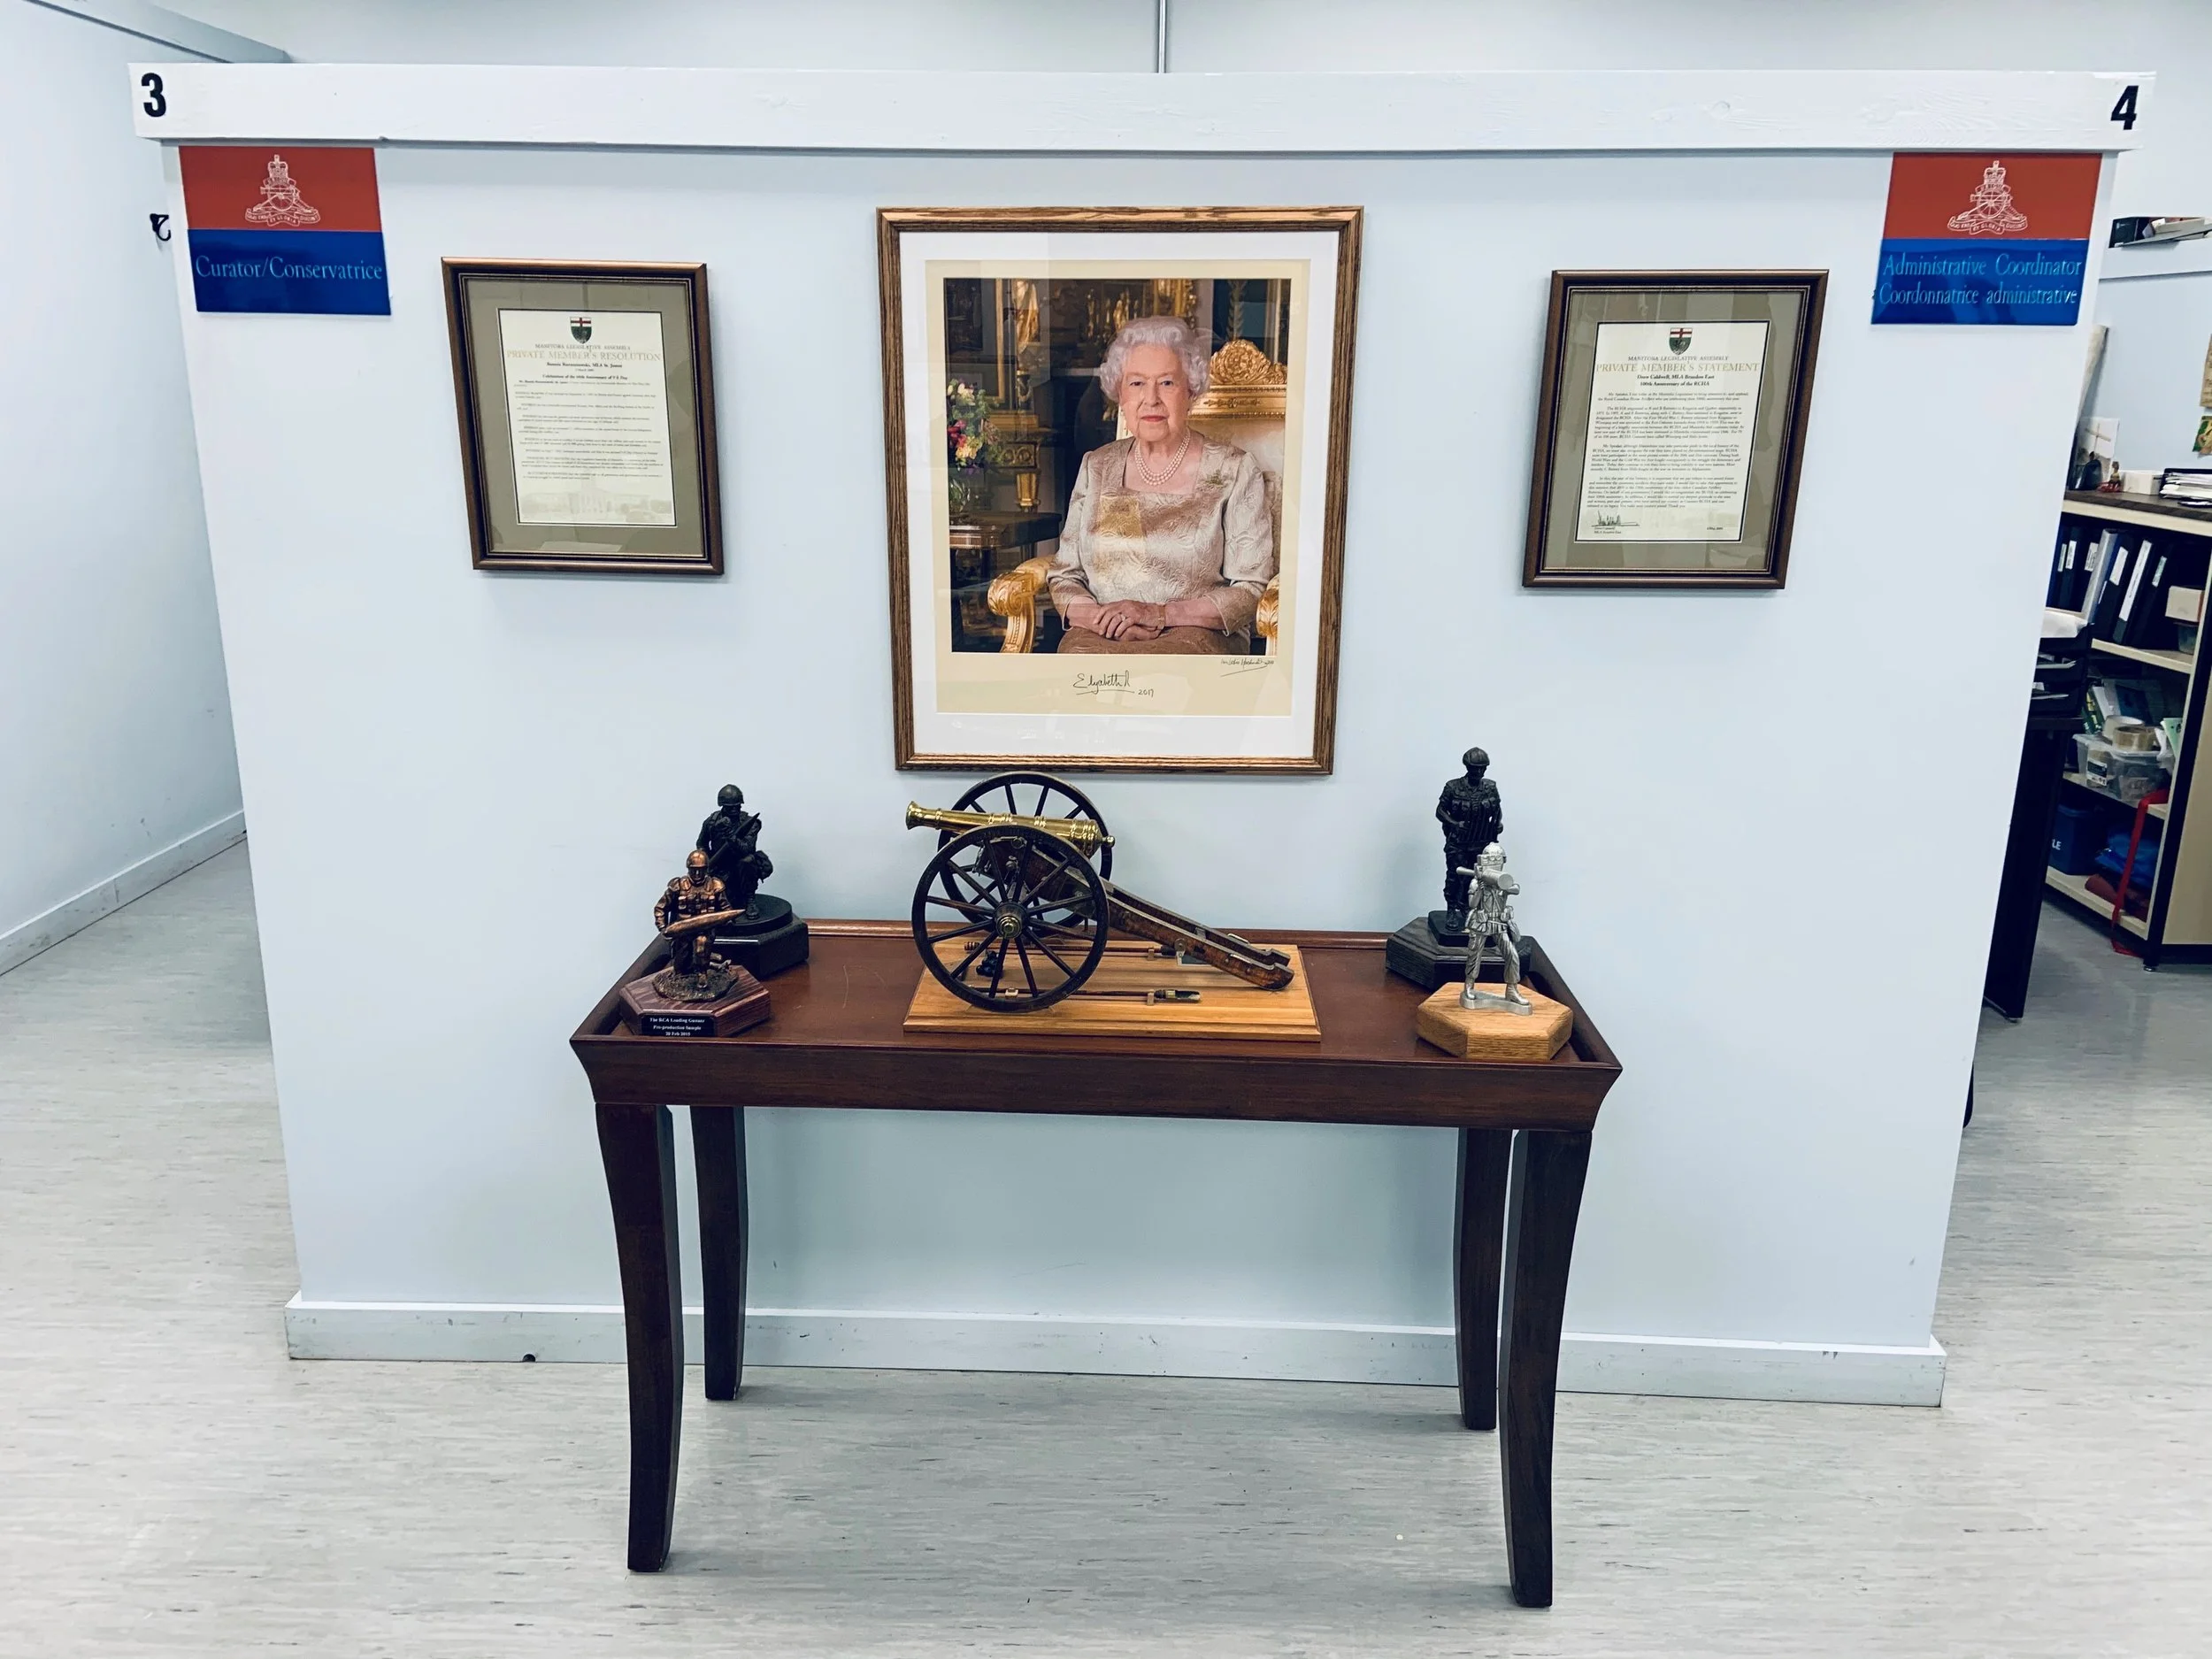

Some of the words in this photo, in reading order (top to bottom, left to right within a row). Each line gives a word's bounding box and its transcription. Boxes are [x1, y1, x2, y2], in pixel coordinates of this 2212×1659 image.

[141, 72, 166, 118] 3
[2110, 85, 2139, 130] 4
[196, 255, 383, 280] Curator/Conservatrice
[1882, 251, 1987, 276] Administrative
[1995, 252, 2083, 276] Coordinator
[1879, 281, 1980, 305] Coordonnatrice
[1986, 281, 2078, 305] administrative
[506, 349, 546, 358] PRIVATE
[548, 350, 597, 360] MEMBER'S
[600, 351, 661, 361] RESOLUTION
[1596, 363, 1639, 373] PRIVATE
[1640, 361, 1694, 373] MEMBER'S
[1698, 363, 1759, 372] STATEMENT
[1138, 688, 1155, 698] 2017
